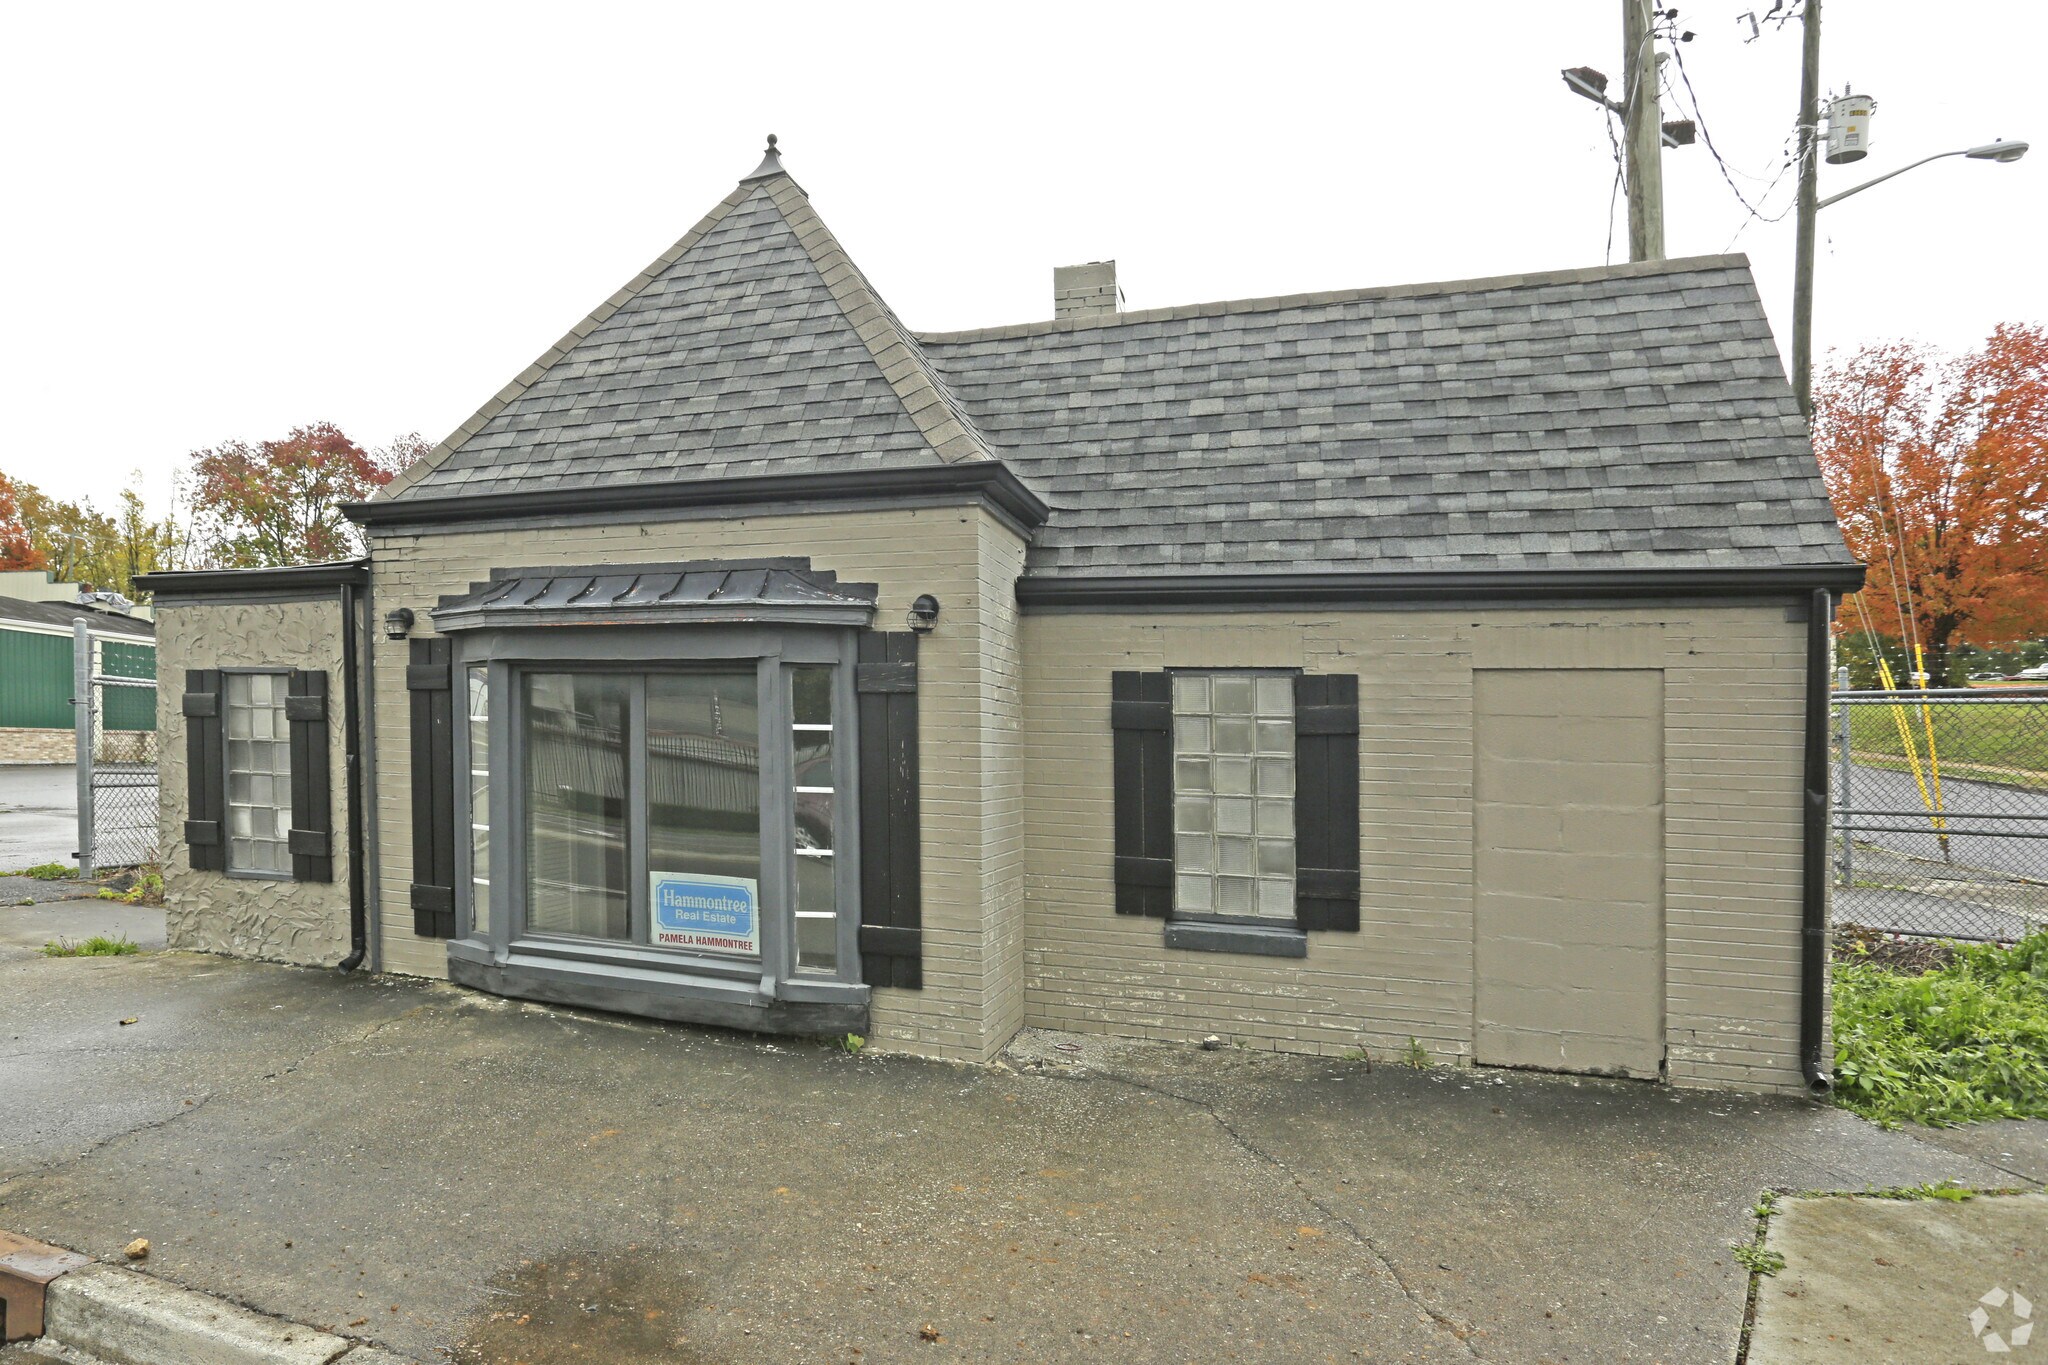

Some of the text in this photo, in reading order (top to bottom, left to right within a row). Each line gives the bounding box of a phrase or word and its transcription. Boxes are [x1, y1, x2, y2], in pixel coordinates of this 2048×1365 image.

[663, 889, 748, 913] Hammontree
[675, 909, 737, 924] Real Estate
[659, 933, 753, 951] PAMELA HAMMONTREE
